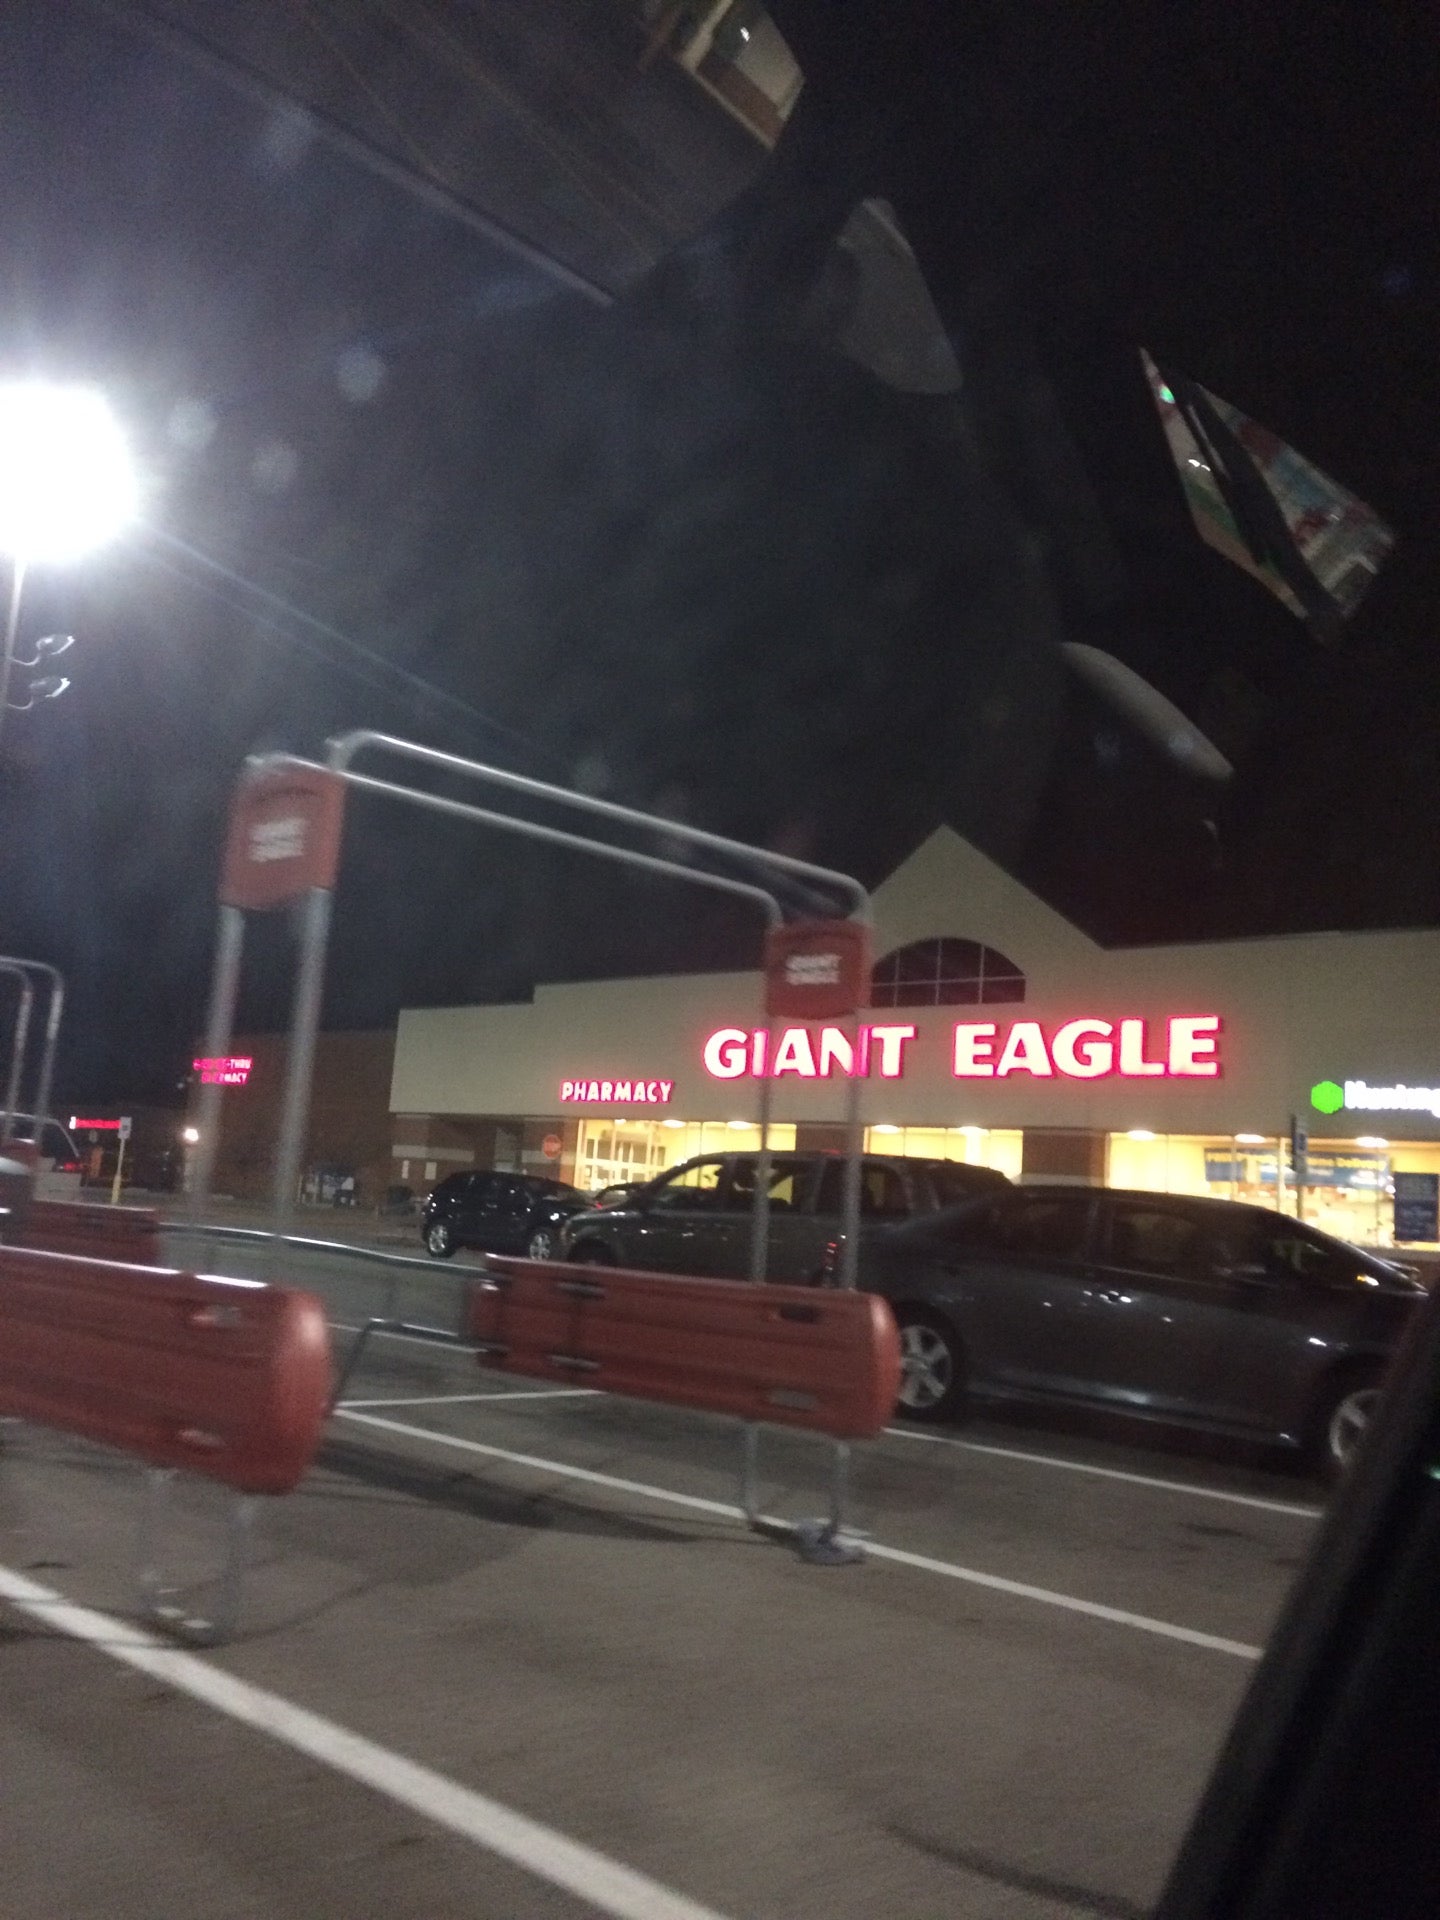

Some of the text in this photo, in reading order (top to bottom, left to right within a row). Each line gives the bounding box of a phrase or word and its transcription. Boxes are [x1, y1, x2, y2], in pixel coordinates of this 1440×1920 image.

[703, 1015, 1222, 1079] GIANT EAGLE
[560, 1080, 673, 1103] PHARMACY
